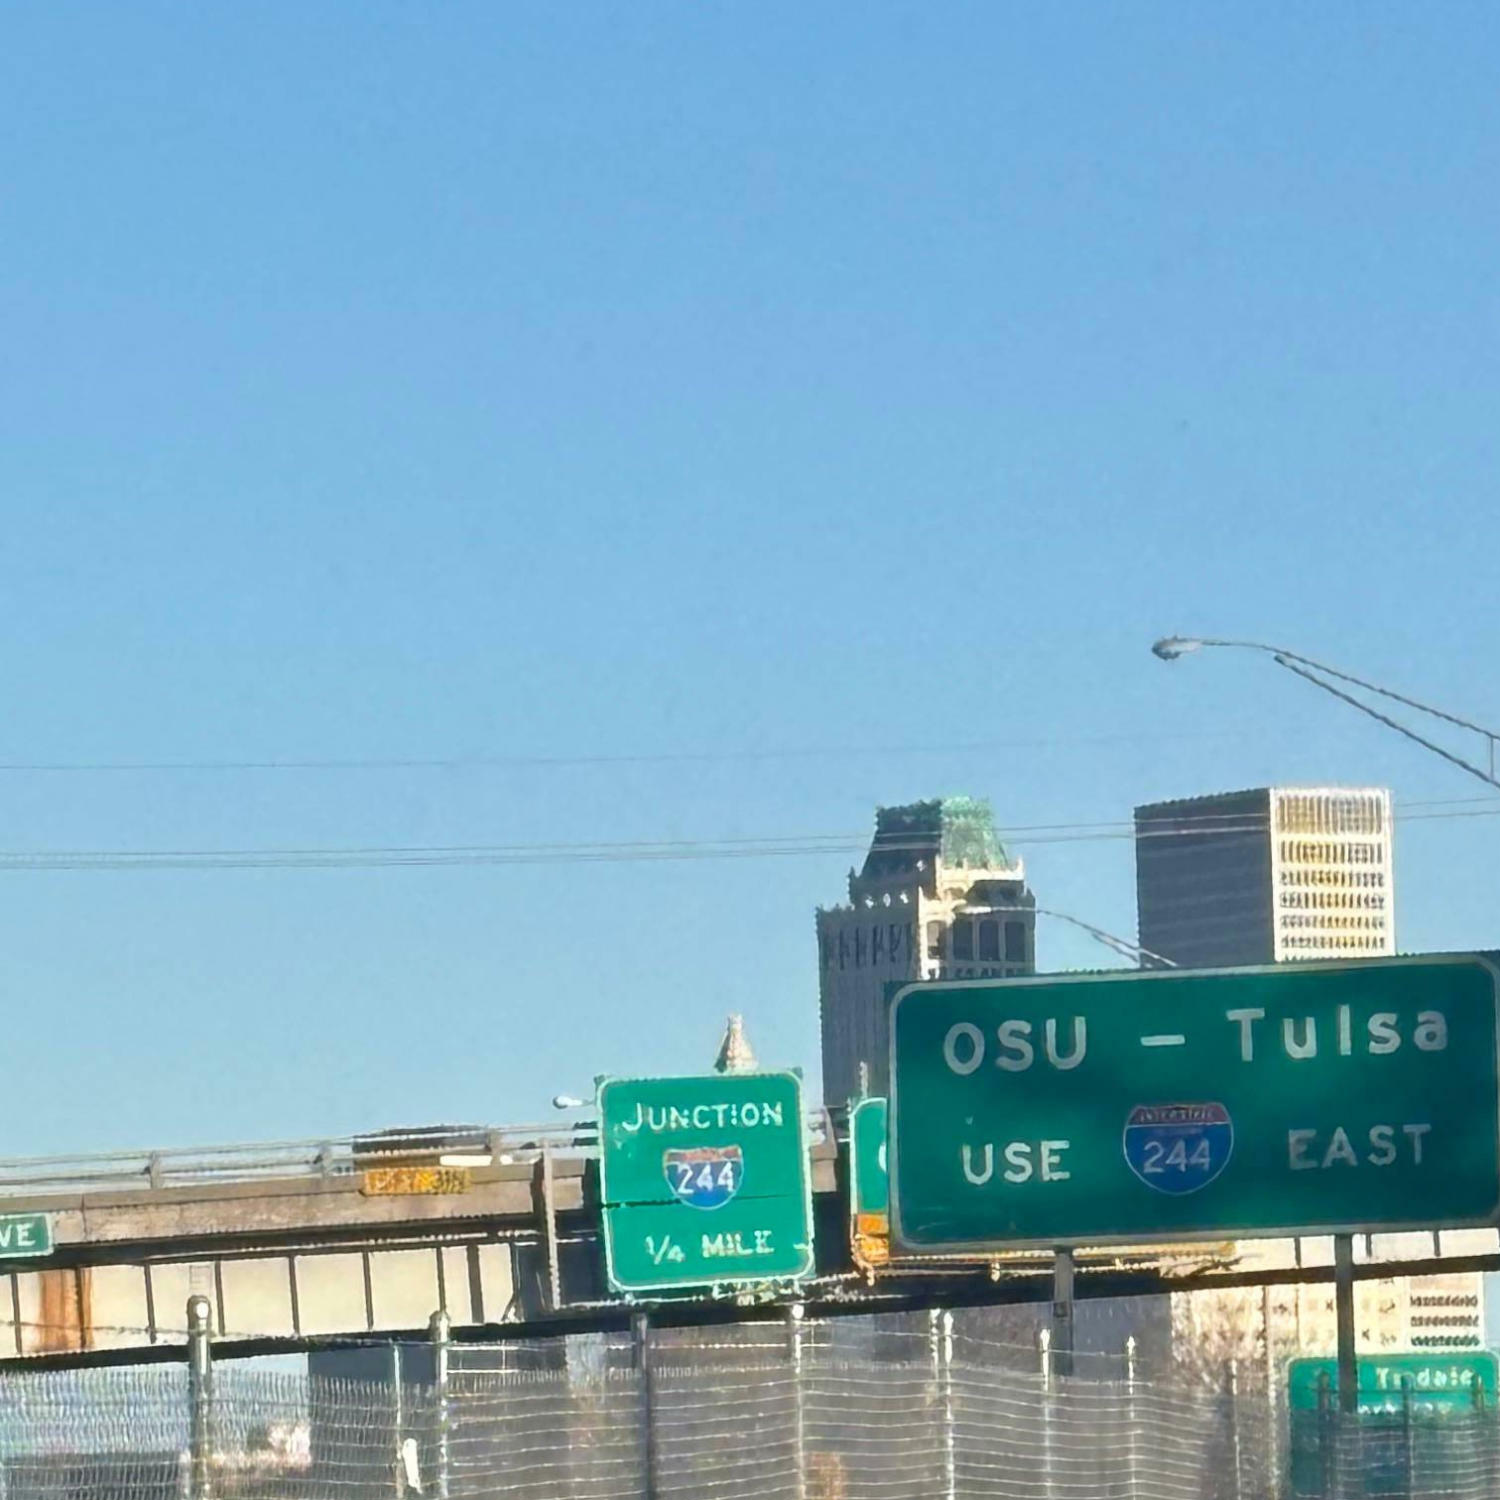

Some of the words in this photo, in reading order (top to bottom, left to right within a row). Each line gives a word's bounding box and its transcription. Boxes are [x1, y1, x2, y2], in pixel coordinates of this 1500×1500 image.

[944, 1016, 1087, 1076] OSU
[1226, 1003, 1449, 1063] Tulsa
[621, 1102, 784, 1132] JUNCTION
[962, 1139, 1070, 1186] USE
[1143, 1138, 1211, 1174] 244
[1288, 1123, 1432, 1171] EAST
[677, 1161, 735, 1195] 244
[702, 1230, 775, 1258] MILE
